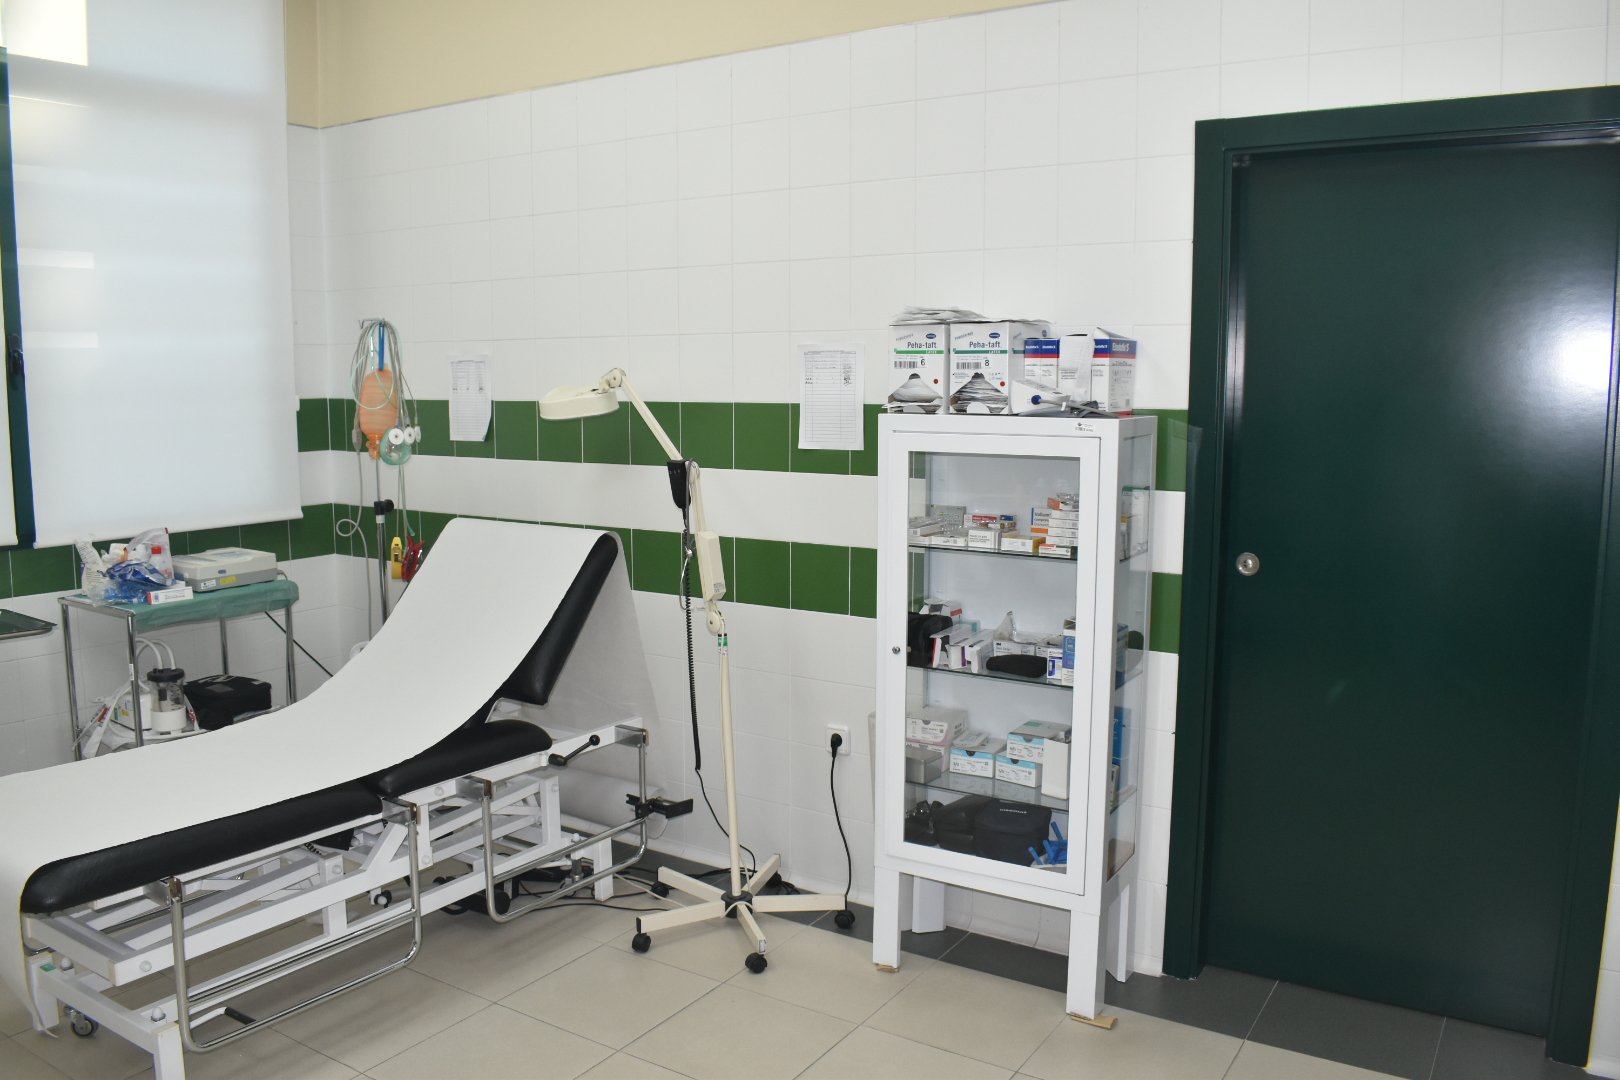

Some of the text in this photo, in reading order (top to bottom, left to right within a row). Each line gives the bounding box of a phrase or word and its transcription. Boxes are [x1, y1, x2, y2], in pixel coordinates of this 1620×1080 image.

[907, 341, 937, 349] Peha-taft
[969, 341, 1001, 349] Peha-taft
[920, 358, 926, 366] 6
[984, 359, 990, 367] 8
